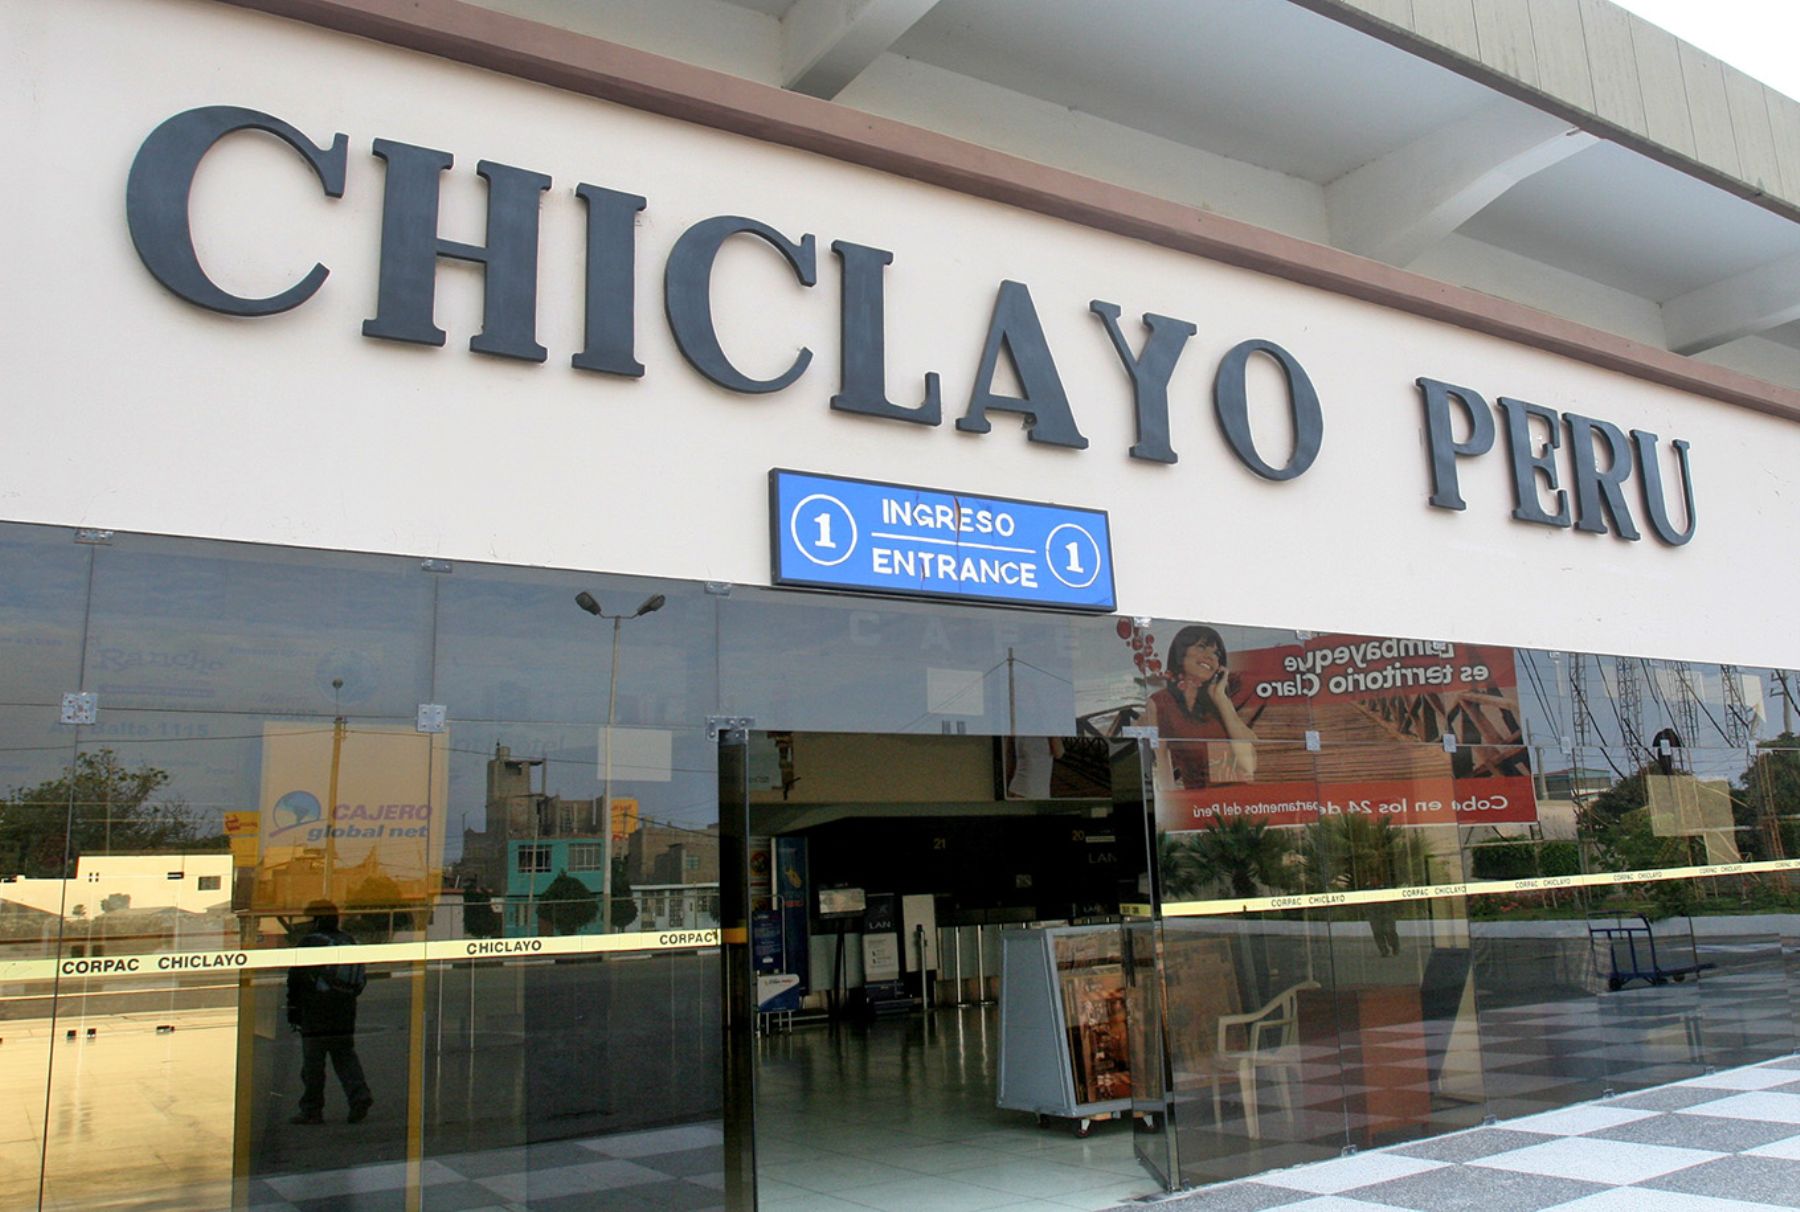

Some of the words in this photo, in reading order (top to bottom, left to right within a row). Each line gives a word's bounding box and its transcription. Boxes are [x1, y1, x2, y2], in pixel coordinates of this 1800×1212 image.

[126, 105, 1323, 482] CHICLAYO
[1416, 377, 1697, 546] PERU
[882, 498, 1015, 538] INGRESO
[813, 512, 837, 549] 1
[1064, 541, 1084, 575] 1
[872, 548, 1038, 589] ENTRANCE
[332, 804, 432, 821] CAJERO
[307, 824, 384, 841] global
[388, 825, 428, 838] net
[1402, 888, 1429, 898] CORPAC
[1435, 885, 1467, 895] CHICLAYO
[1515, 880, 1538, 889] CORPAC
[1543, 878, 1571, 887] CHICLAYO
[1271, 897, 1302, 908] CORPAC
[1309, 894, 1345, 905] CHICLAYO
[869, 920, 892, 930] LAN
[659, 932, 714, 945] CORPAC
[466, 940, 542, 955] CHICLAYO
[62, 958, 140, 975] CORPAC
[158, 953, 247, 969] CHICLAYO
